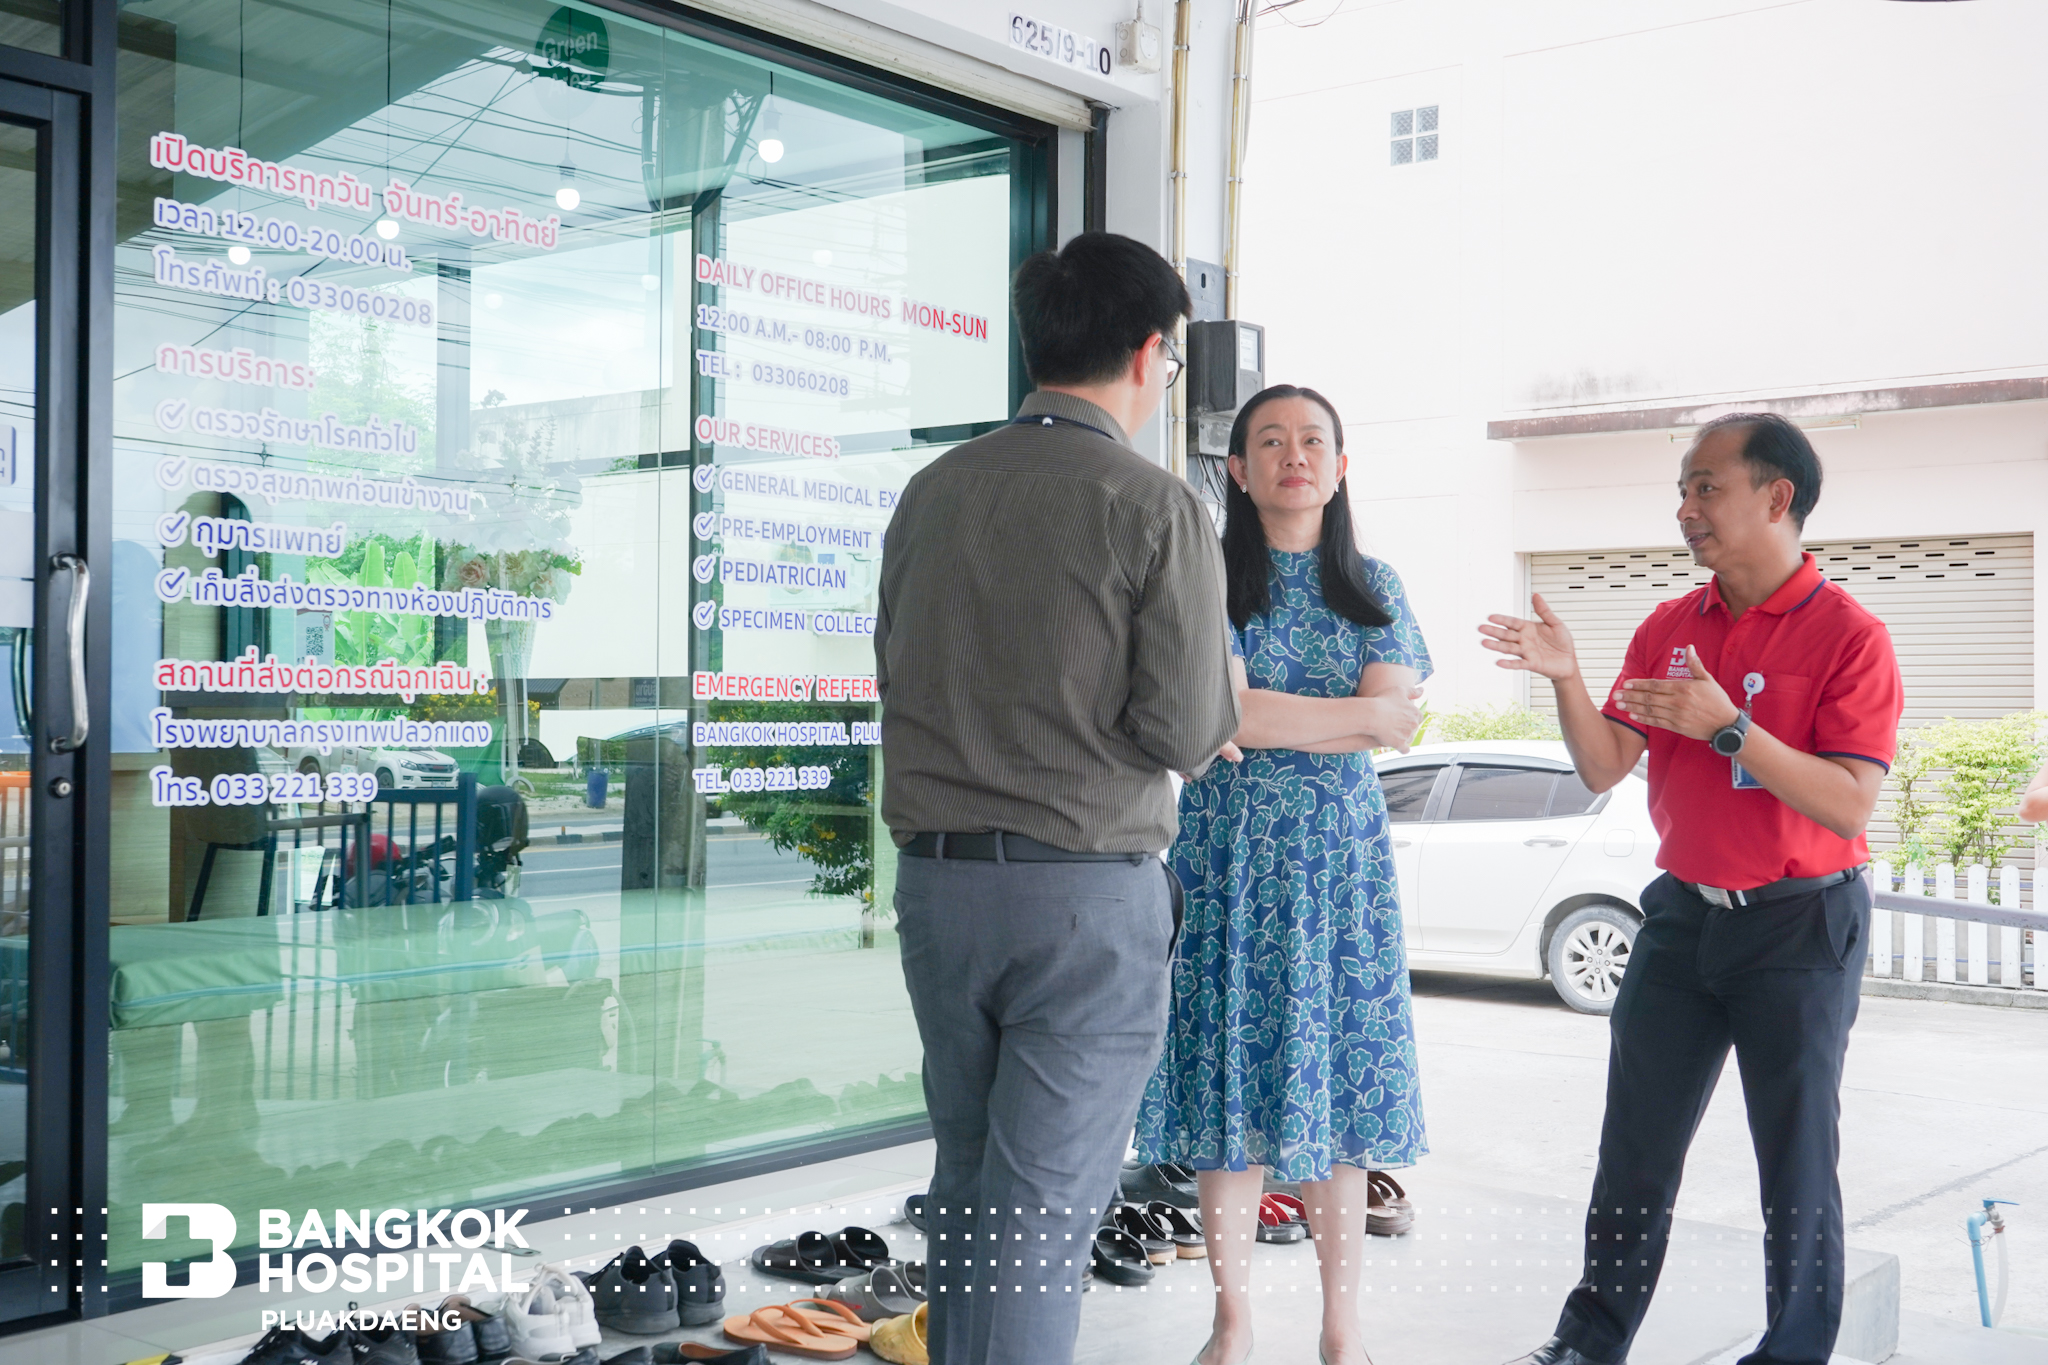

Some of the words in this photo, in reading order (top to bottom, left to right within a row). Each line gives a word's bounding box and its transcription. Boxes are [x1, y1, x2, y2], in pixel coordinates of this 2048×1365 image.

[541, 31, 598, 60] Green
[1011, 15, 1111, 76] 625/9-10
[155, 135, 370, 208] เปิดบริการทุกวัน
[387, 182, 558, 248] จันทร์-อาทิตย์
[157, 203, 215, 232] เวลา
[157, 249, 262, 298] โทรศัพท์
[290, 279, 432, 325] 033060208
[698, 257, 755, 290] DAILY
[760, 272, 825, 304] OFFICE
[831, 287, 891, 319] HOURS
[903, 301, 987, 340] MON-SUN
[699, 308, 750, 334] 12:00
[805, 329, 851, 354] 08:00
[859, 339, 892, 362] P.M.
[160, 346, 315, 389] การบริการ:
[752, 363, 849, 396] 033060208
[196, 411, 416, 453] ตรวจรักษาโรคทั่วไป
[697, 418, 741, 445] OUR
[746, 425, 839, 459] SERVICES:
[194, 466, 468, 511] ตรวจสุขภาพก่อนเข้างาน
[721, 471, 799, 497] GENERAL
[804, 481, 873, 507] MEDICAL
[197, 521, 342, 555] กุมารแพทย์
[721, 517, 872, 549] PRE-EMPLOYMENT
[723, 561, 846, 589] PEDIATRICIAN
[195, 569, 551, 620] เก็บสิ่งส่งตรวจทางห้องปฏิบัติการ
[721, 609, 805, 630] SPECIMEN
[158, 649, 472, 701] สถานที่ส่งต่อกรณีฉุกเฉิน
[696, 674, 813, 698] EMERGENCY
[156, 712, 490, 752] โรงพยาบาลกรุงเทพปลวกแดง
[696, 726, 775, 743] BANGKOK
[777, 726, 848, 743] HOSPITAL
[156, 769, 210, 802] โทร.
[216, 776, 264, 801] 033
[275, 776, 320, 800] 221
[330, 776, 375, 800] 339
[696, 773, 728, 789] TEL.
[733, 772, 762, 789] 033
[768, 771, 795, 787] 221
[801, 769, 829, 786] 339
